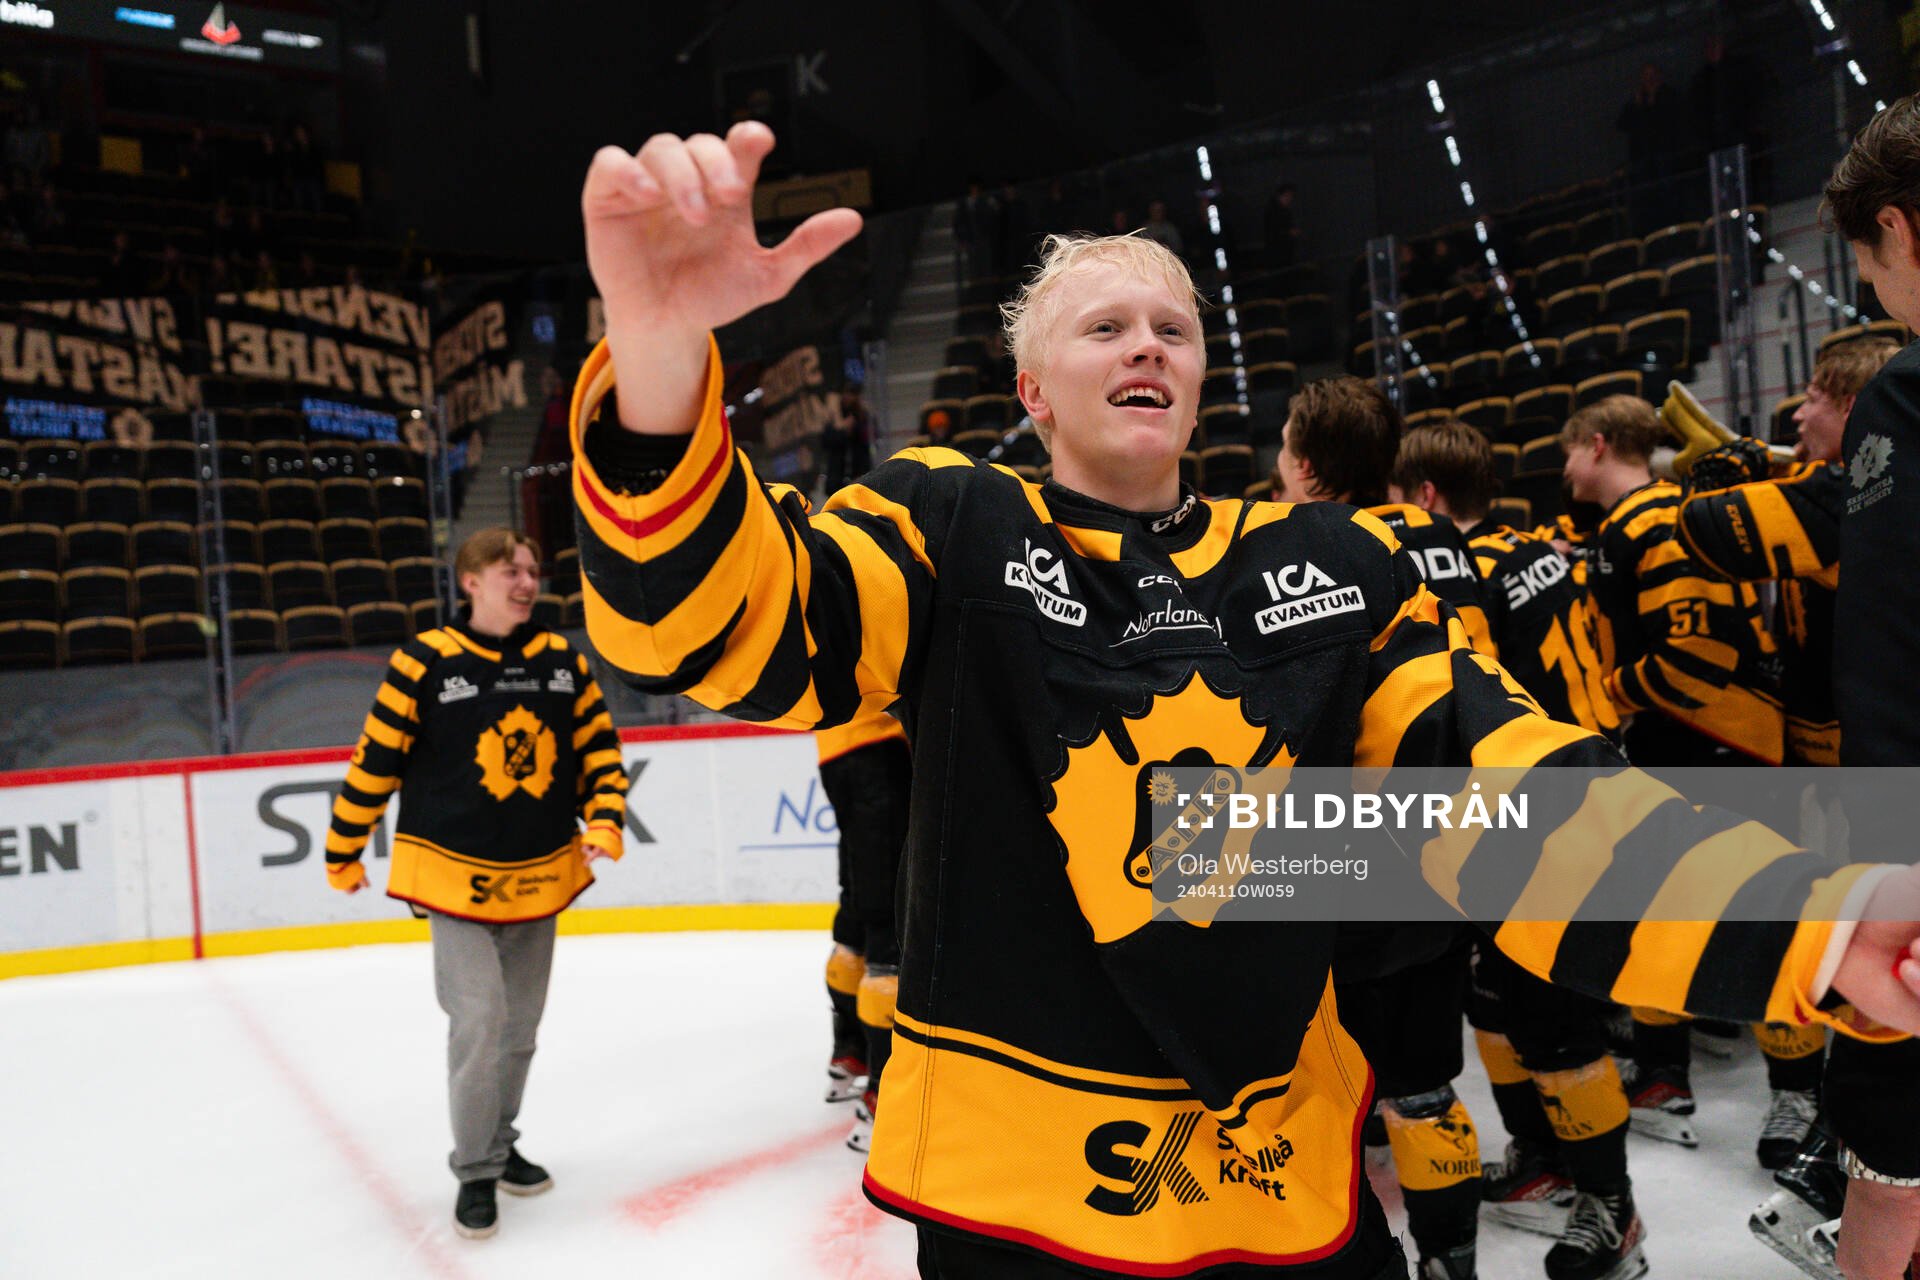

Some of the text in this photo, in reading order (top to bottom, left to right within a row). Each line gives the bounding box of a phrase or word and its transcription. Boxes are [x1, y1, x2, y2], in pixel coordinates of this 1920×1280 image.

[796, 52, 829, 96] K
[1024, 537, 1070, 595] ICA
[1262, 561, 1338, 601] ICA
[1011, 566, 1082, 621] KVNTUM
[1261, 591, 1360, 628] KVANTUM
[1668, 600, 1710, 636] 51
